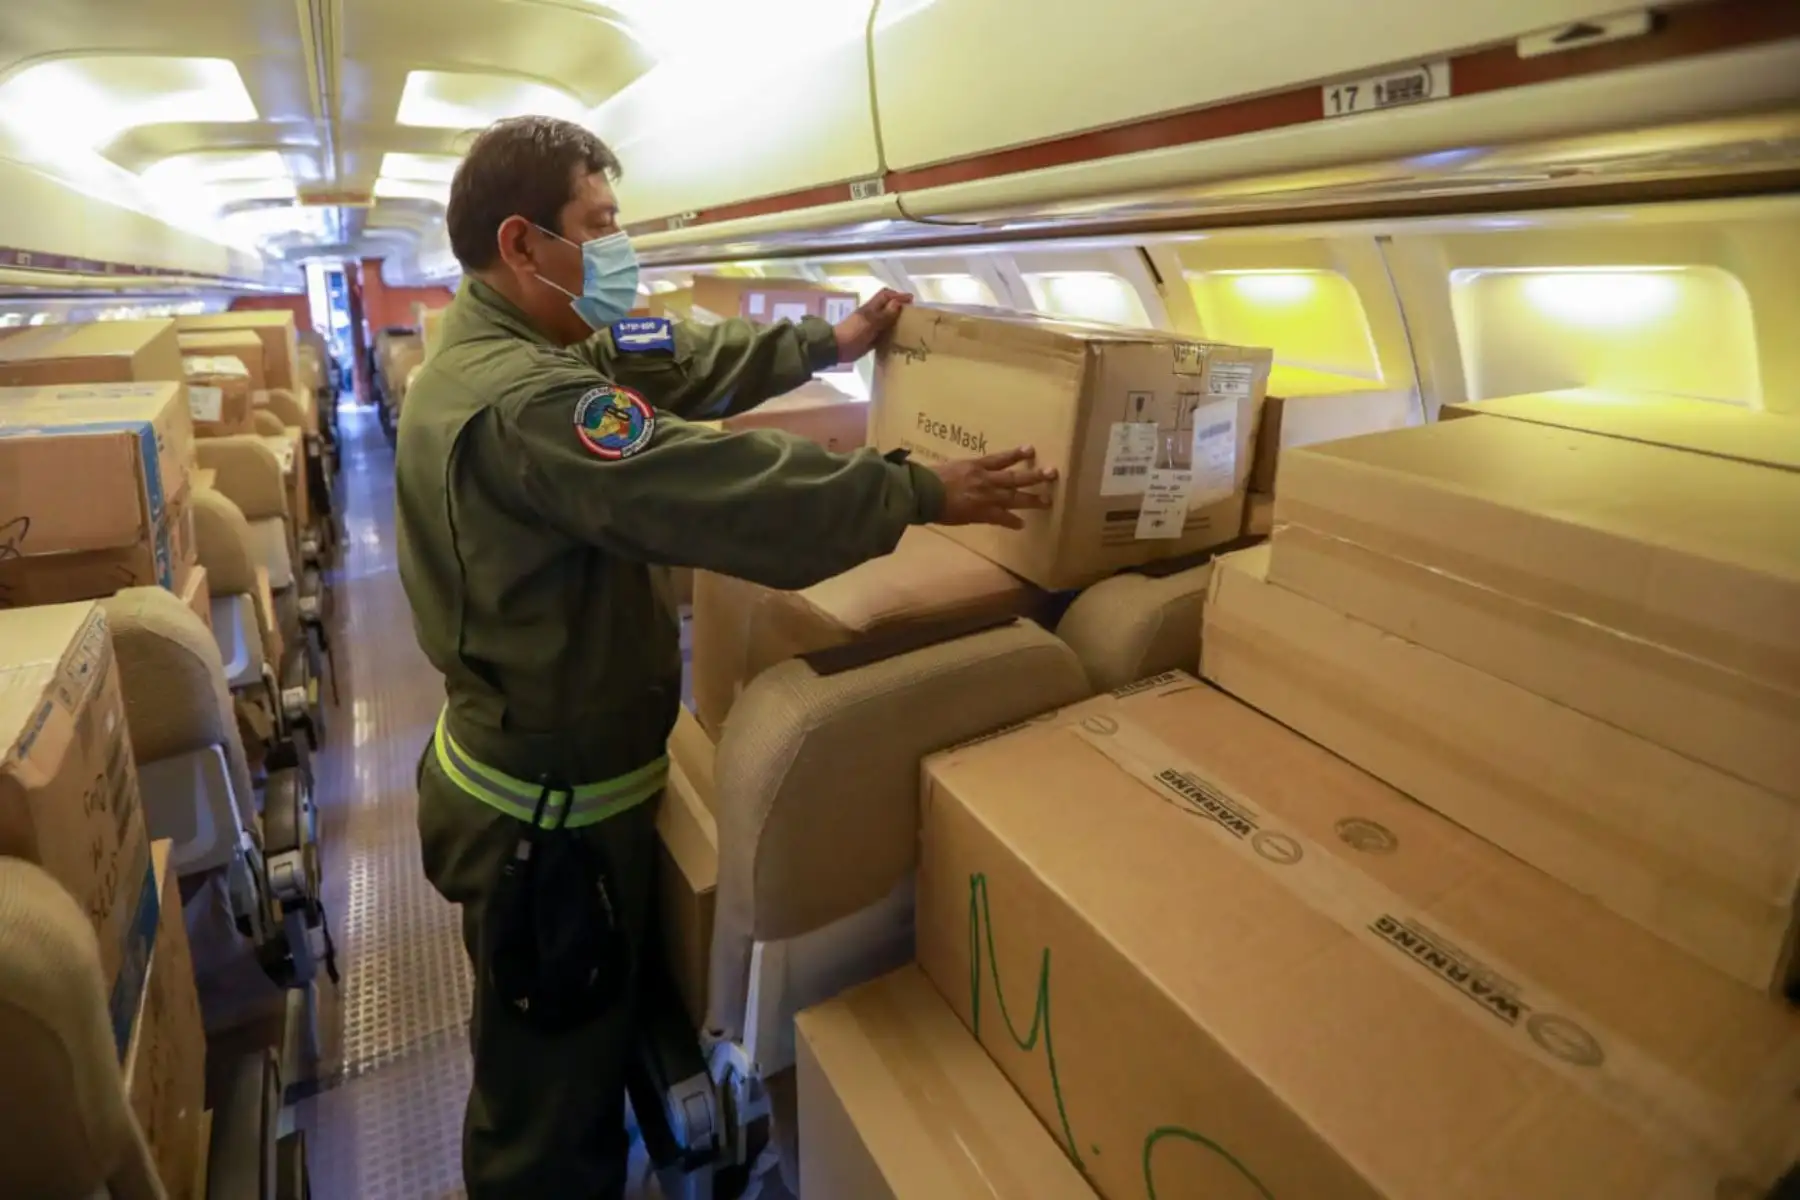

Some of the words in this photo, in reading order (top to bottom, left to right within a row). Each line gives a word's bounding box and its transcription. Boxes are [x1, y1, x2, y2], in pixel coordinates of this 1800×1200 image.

[1330, 86, 1359, 113] 17
[916, 412, 948, 440] Face
[949, 423, 989, 455] Mask
[1159, 769, 1251, 836] WARNING
[1374, 917, 1521, 1022] WARNING
